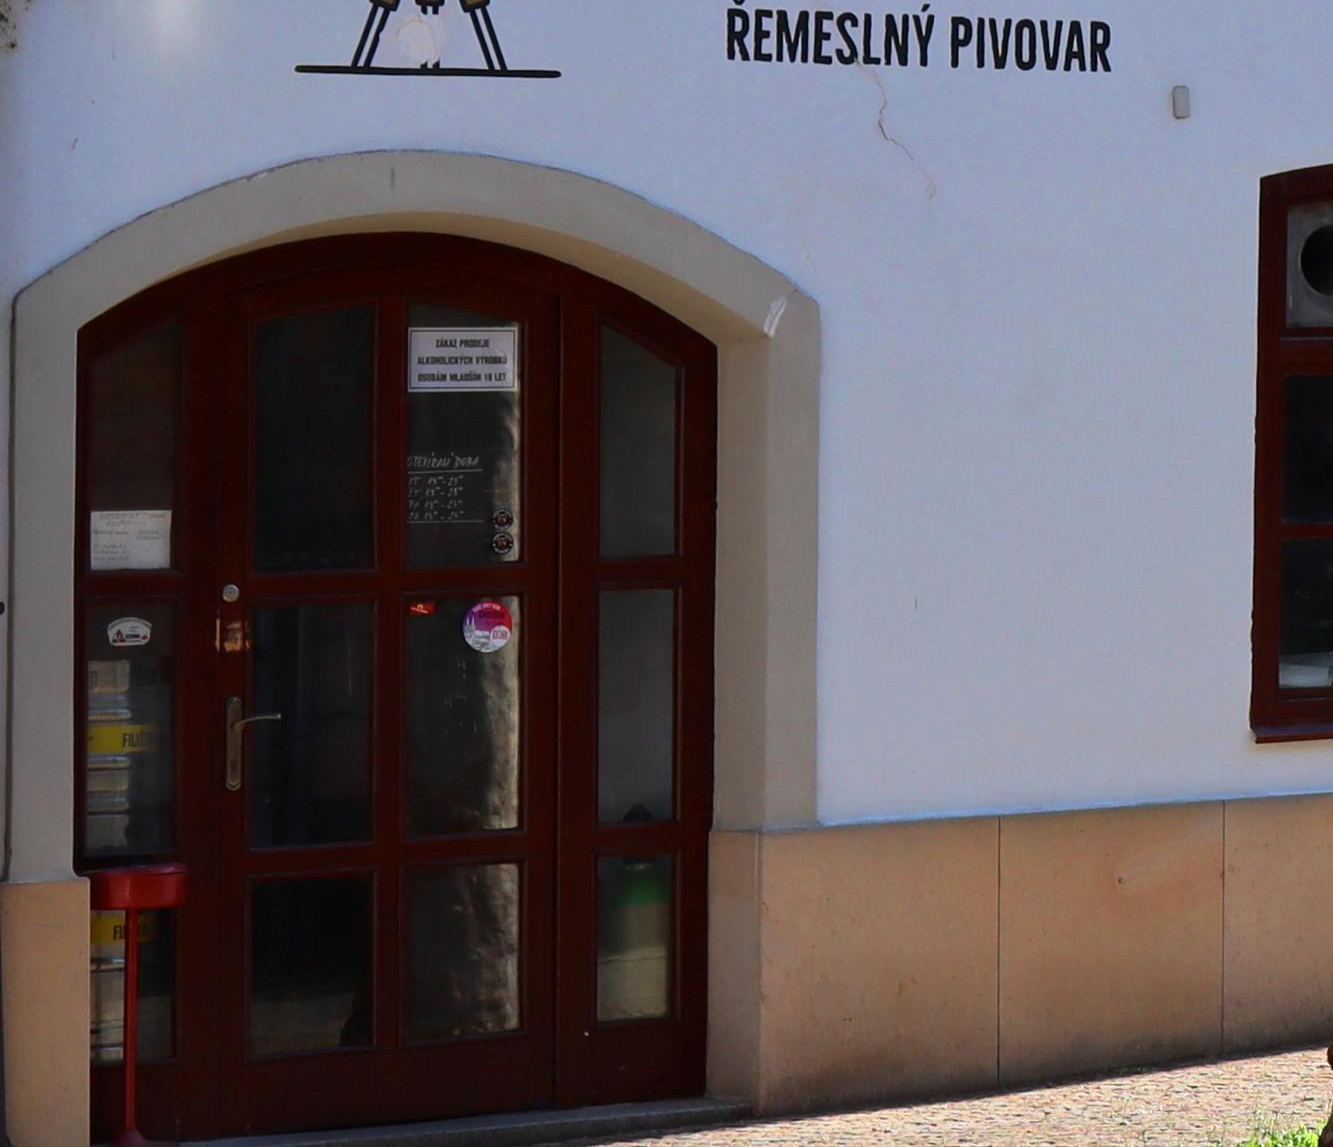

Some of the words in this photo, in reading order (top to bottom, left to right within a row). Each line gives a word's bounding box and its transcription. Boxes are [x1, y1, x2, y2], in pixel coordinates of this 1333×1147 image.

[949, 12, 1113, 73] PIVOVAR
[436, 336, 458, 348] ZÁKAZ
[460, 338, 490, 348] PRODEJE
[494, 372, 506, 381] LET
